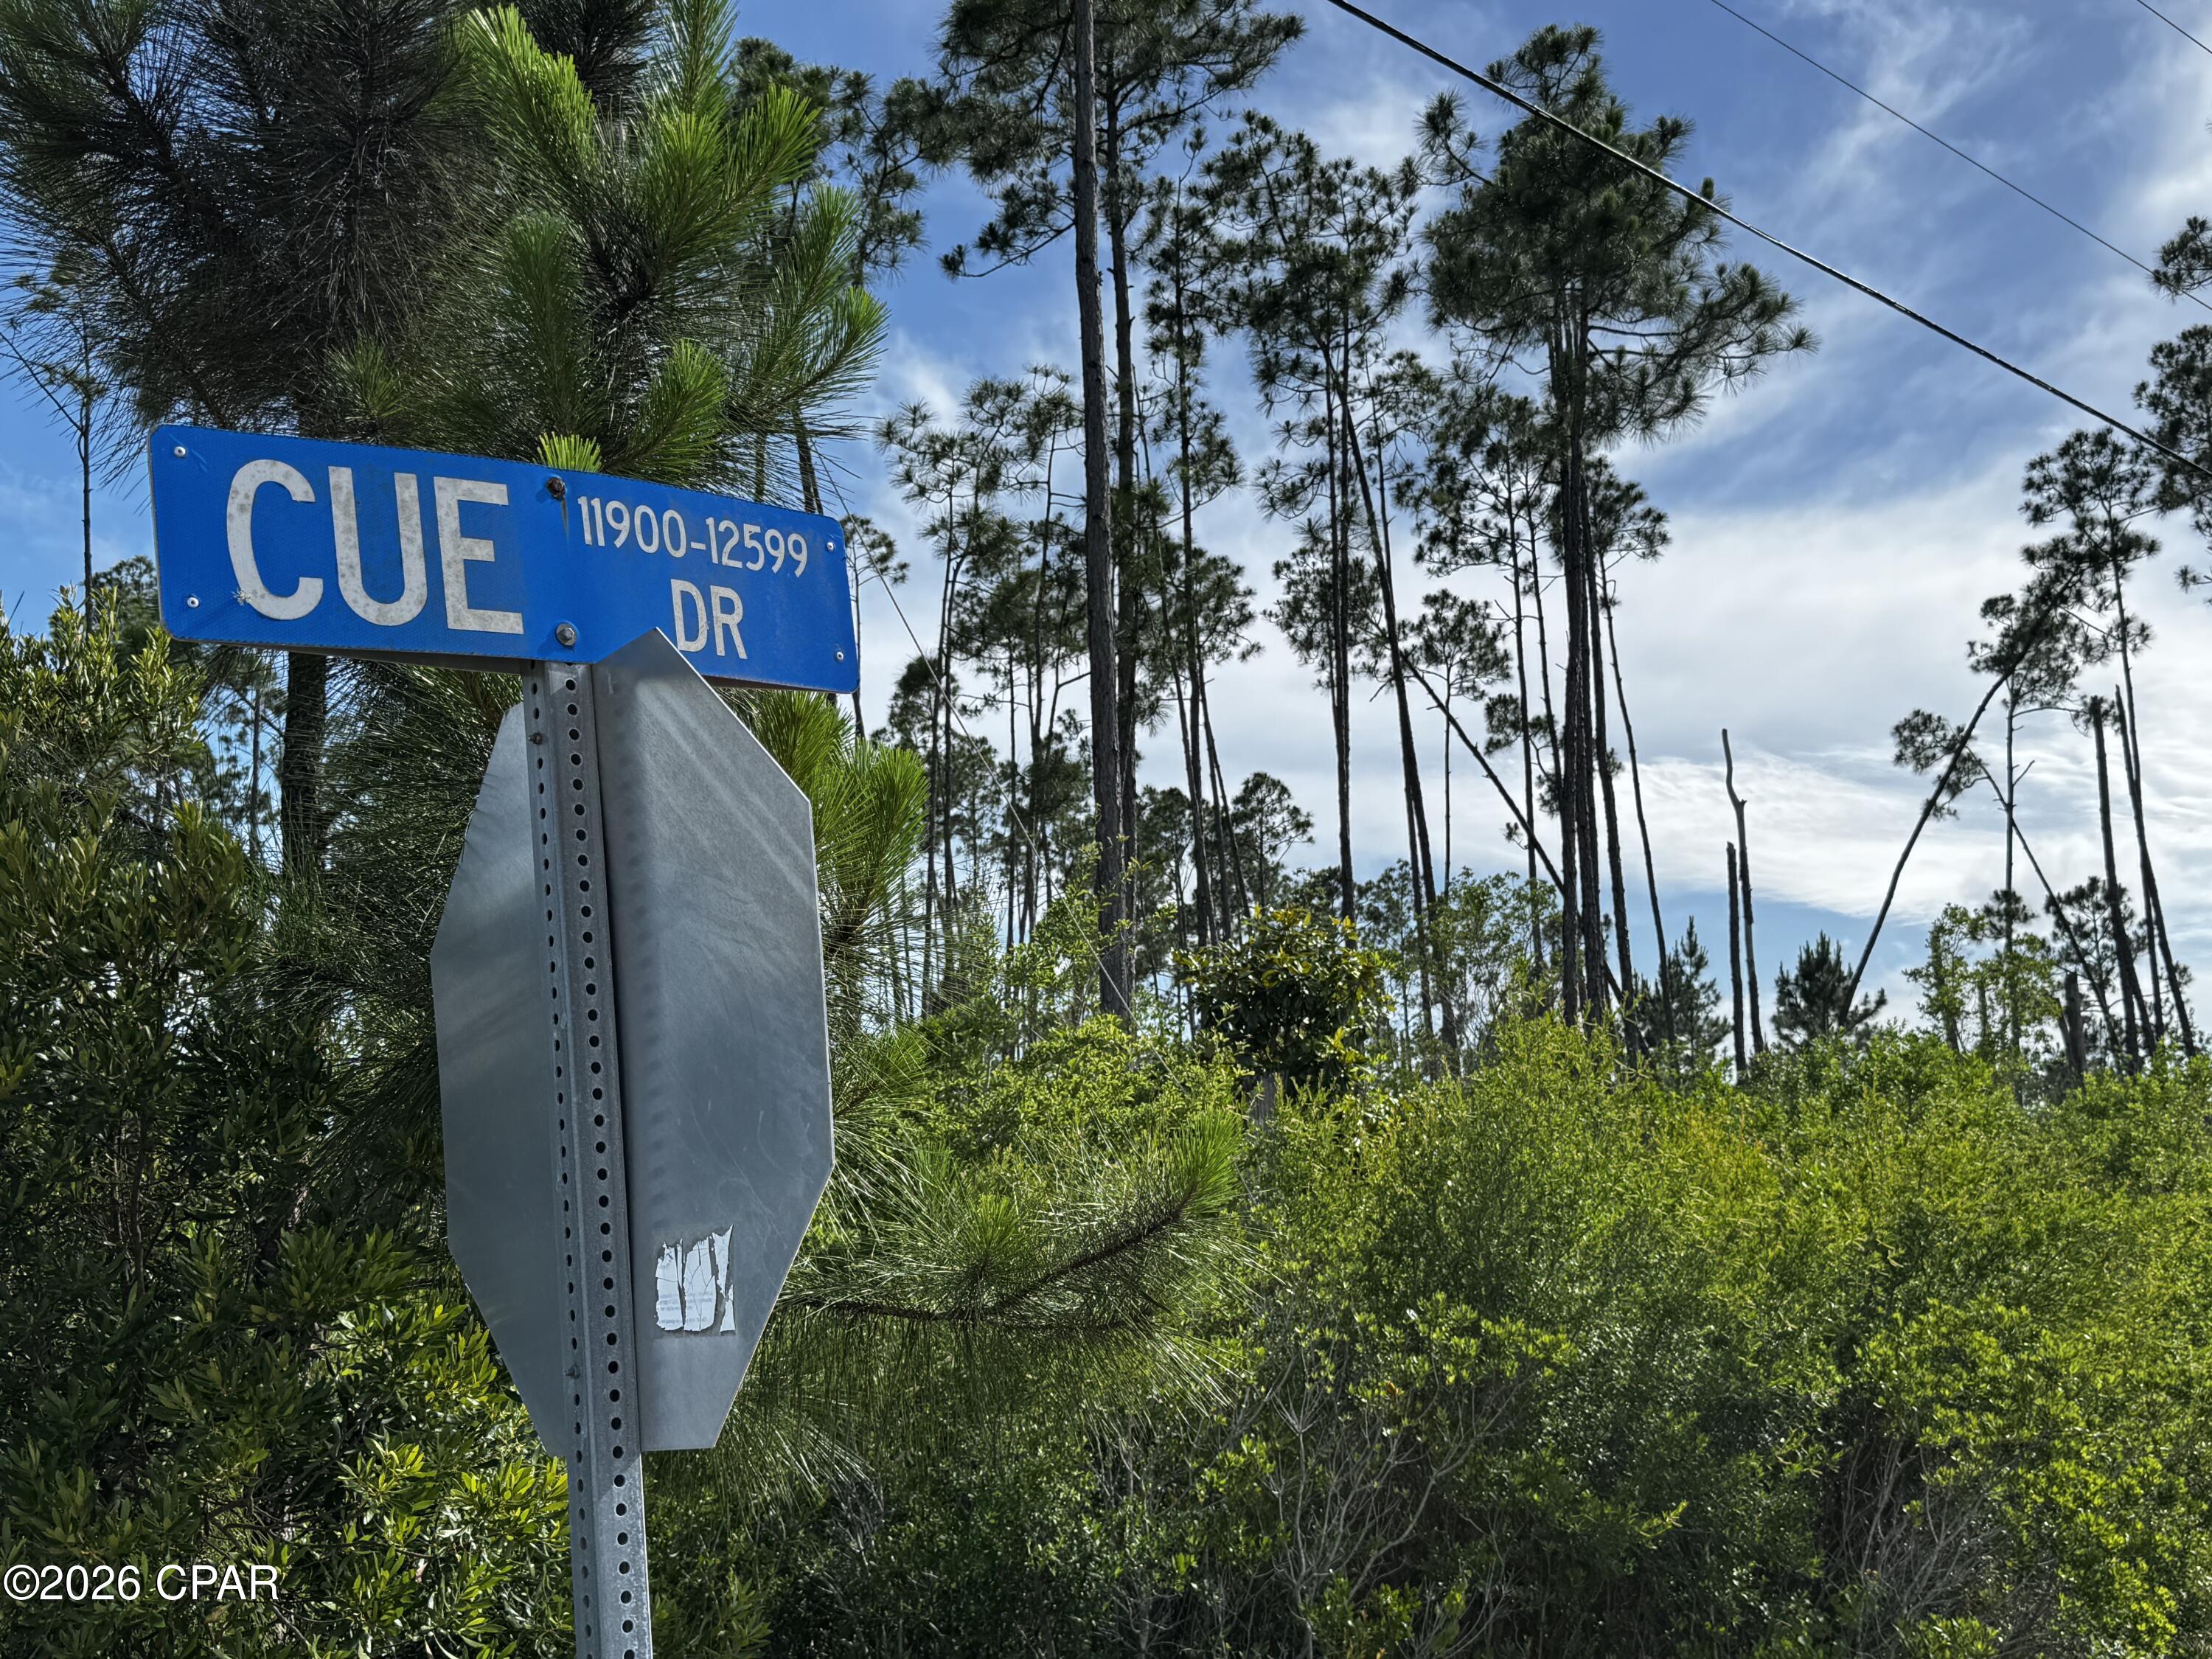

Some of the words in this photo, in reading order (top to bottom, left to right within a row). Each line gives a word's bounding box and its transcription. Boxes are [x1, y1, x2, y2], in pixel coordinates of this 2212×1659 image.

[226, 459, 524, 634] CUE
[577, 495, 807, 577] 11900-12599
[670, 579, 747, 660] DR
